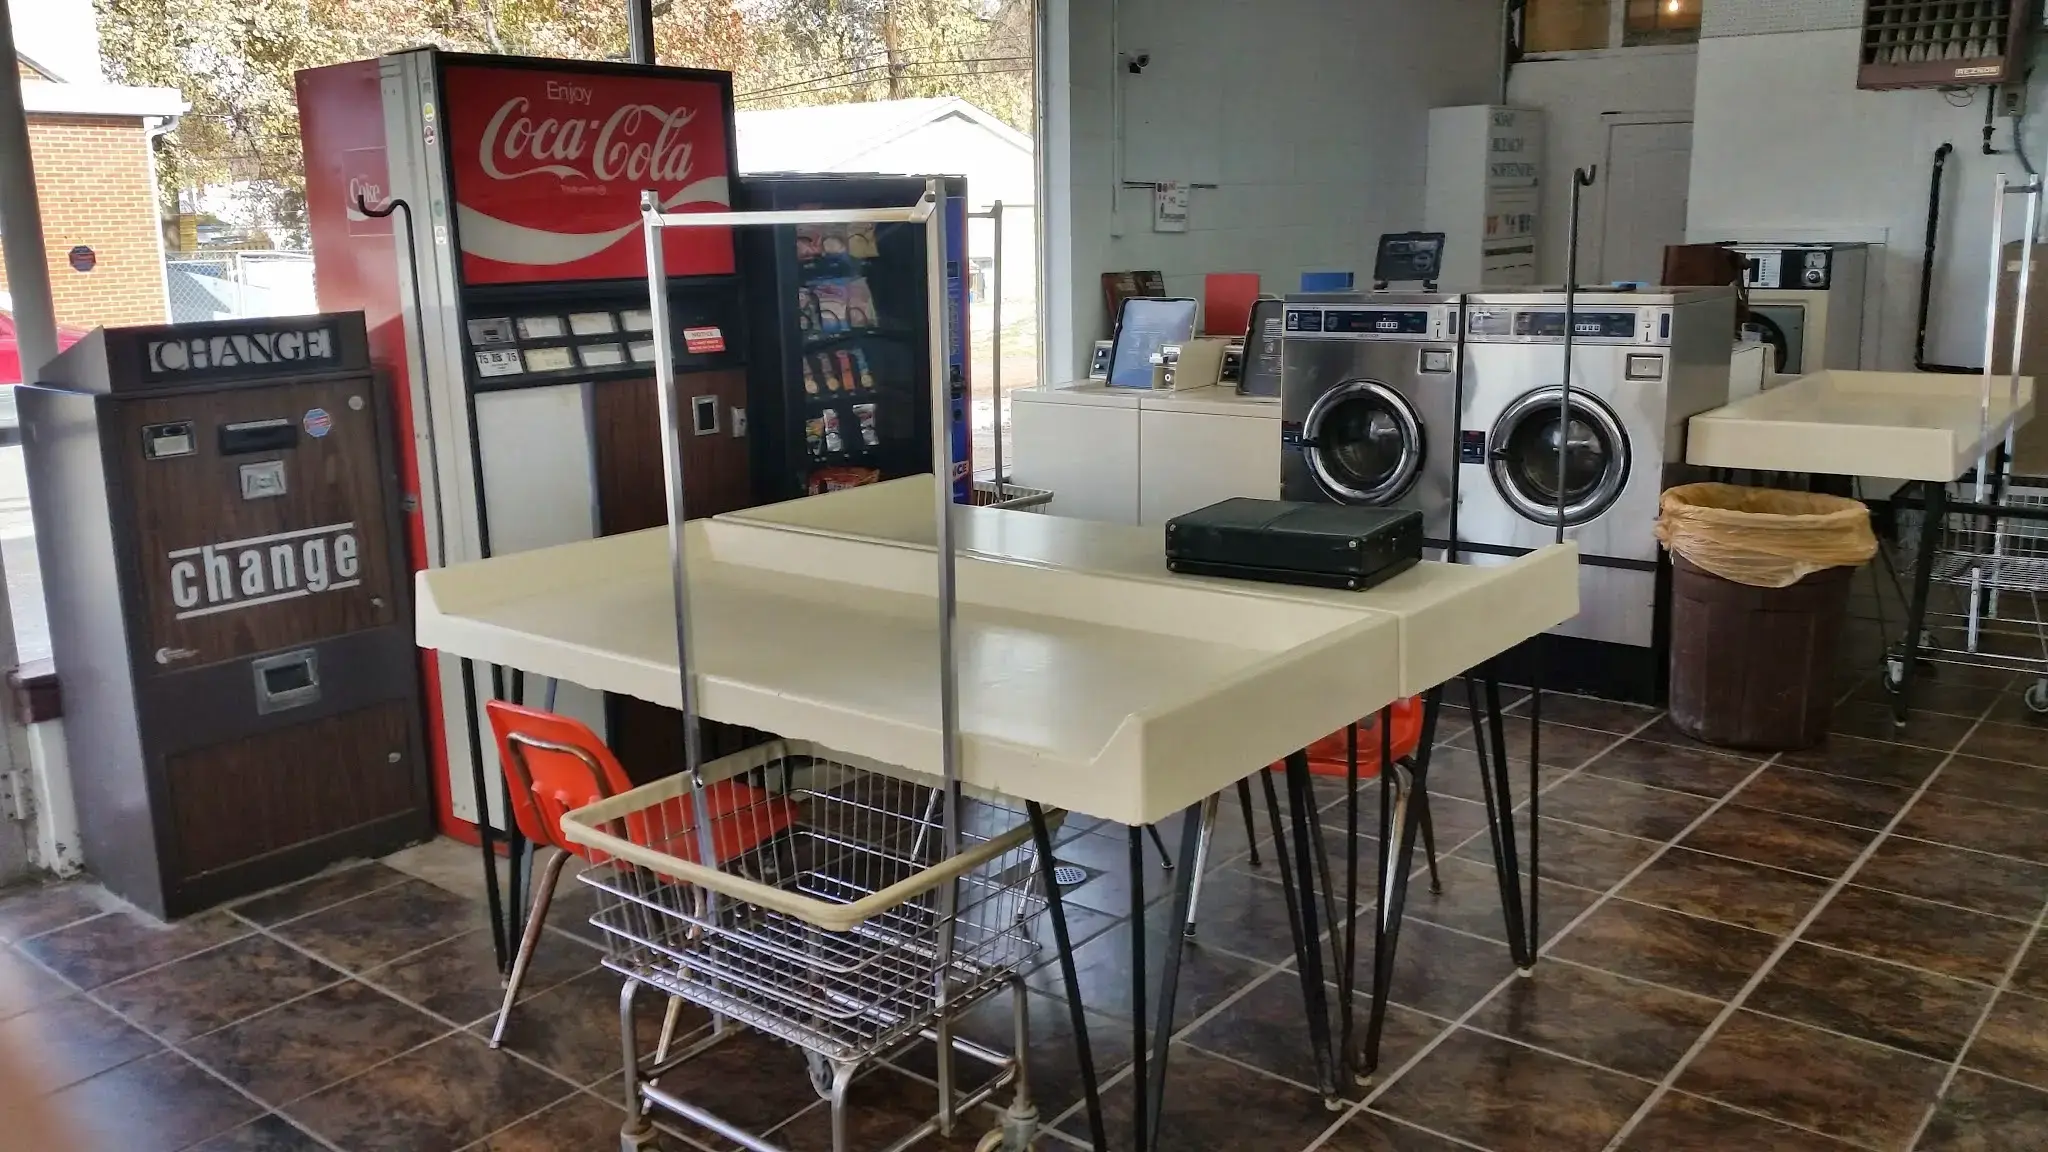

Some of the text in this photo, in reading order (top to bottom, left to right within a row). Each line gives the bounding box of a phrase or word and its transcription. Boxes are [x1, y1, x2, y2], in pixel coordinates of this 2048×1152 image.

[546, 81, 593, 106] Enjoy
[479, 96, 697, 181] Coca-Cola
[349, 178, 380, 204] Coke
[153, 330, 325, 372] CHANGE
[171, 534, 359, 608] change
